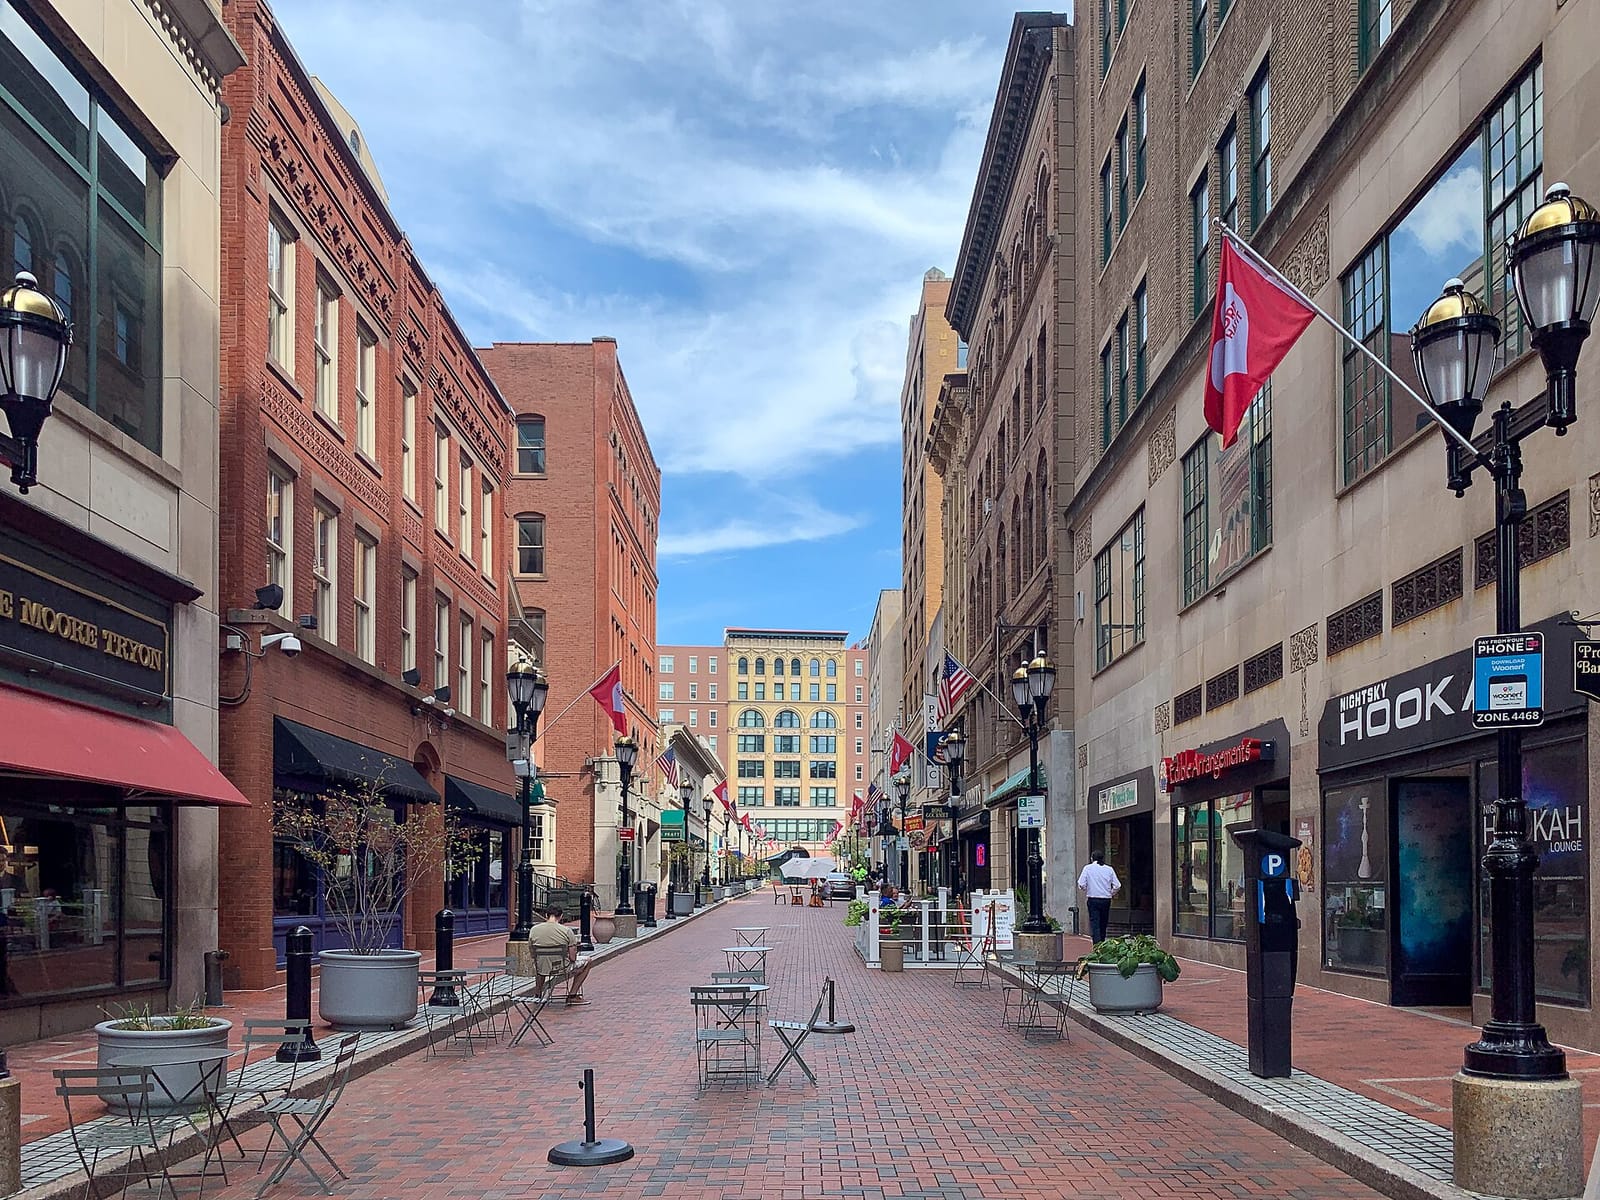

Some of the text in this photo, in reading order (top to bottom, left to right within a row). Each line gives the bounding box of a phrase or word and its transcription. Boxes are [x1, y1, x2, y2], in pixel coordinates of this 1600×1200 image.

[20, 598, 98, 649] MOORE
[102, 629, 163, 672] TRYON
[1479, 643, 1524, 654] PHONE
[1491, 663, 1525, 672] Woonerf
[1340, 681, 1388, 712] NIGHTSKY
[1340, 674, 1474, 746] HOOK
[1476, 711, 1540, 722] ZONE 4468
[1190, 741, 1251, 779] Arrangements
[1483, 805, 1582, 846] HKAH
[1550, 840, 1583, 853] LOUNGE
[1268, 854, 1282, 875] P
